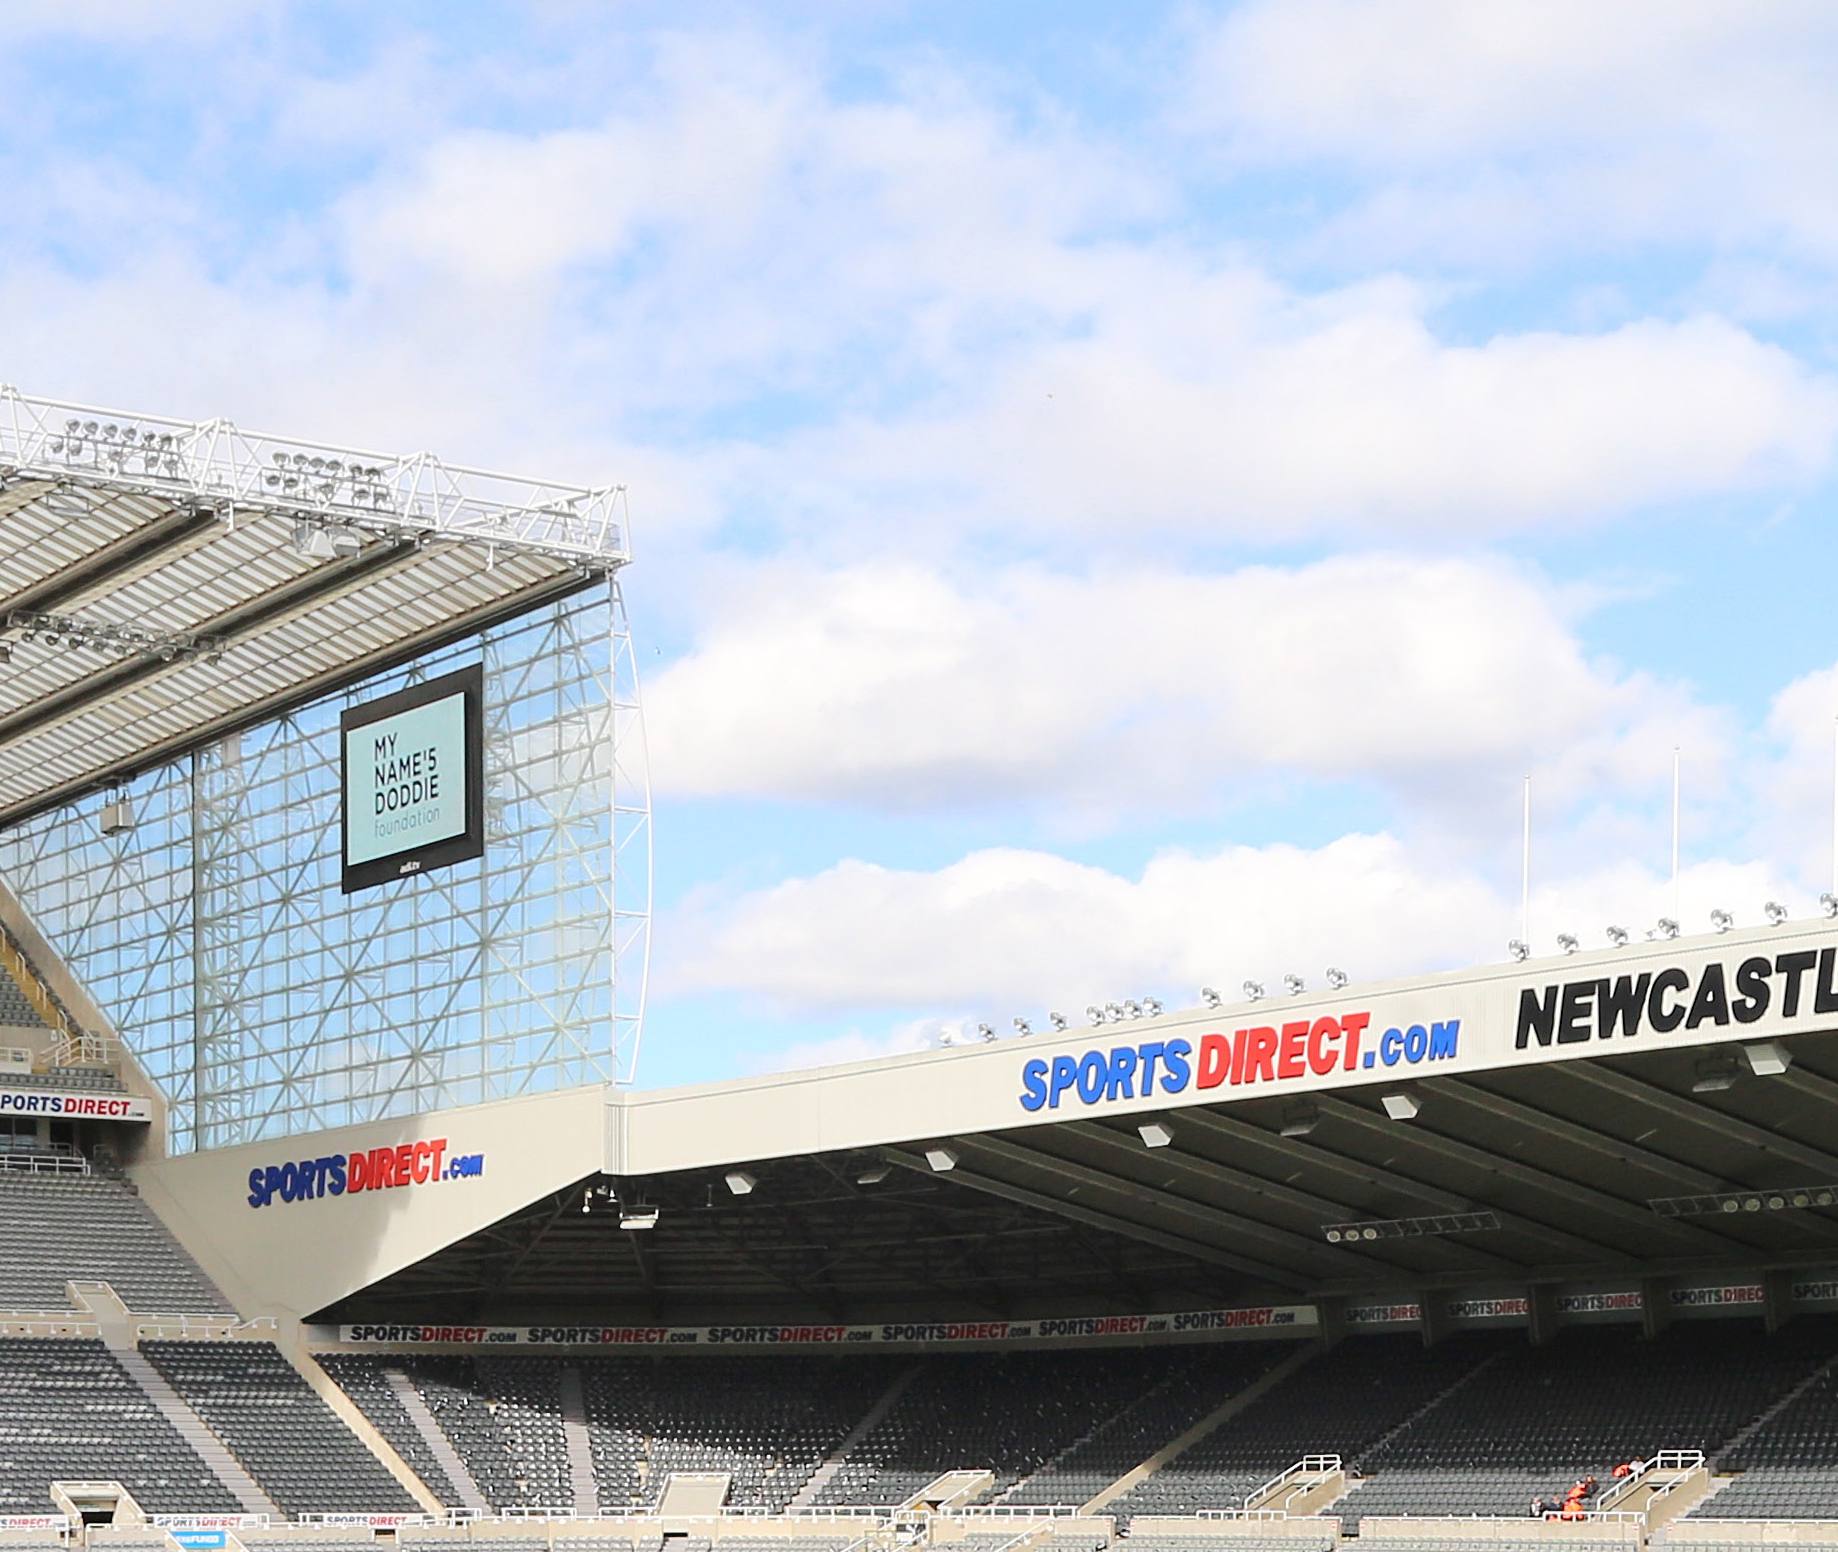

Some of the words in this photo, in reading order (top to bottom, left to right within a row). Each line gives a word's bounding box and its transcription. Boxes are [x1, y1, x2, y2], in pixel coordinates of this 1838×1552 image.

[375, 732, 398, 762] MY
[375, 774, 439, 816] DODDIE
[374, 807, 441, 839] foundation
[1019, 1011, 1460, 1113] SPORTSDIRECT.COM
